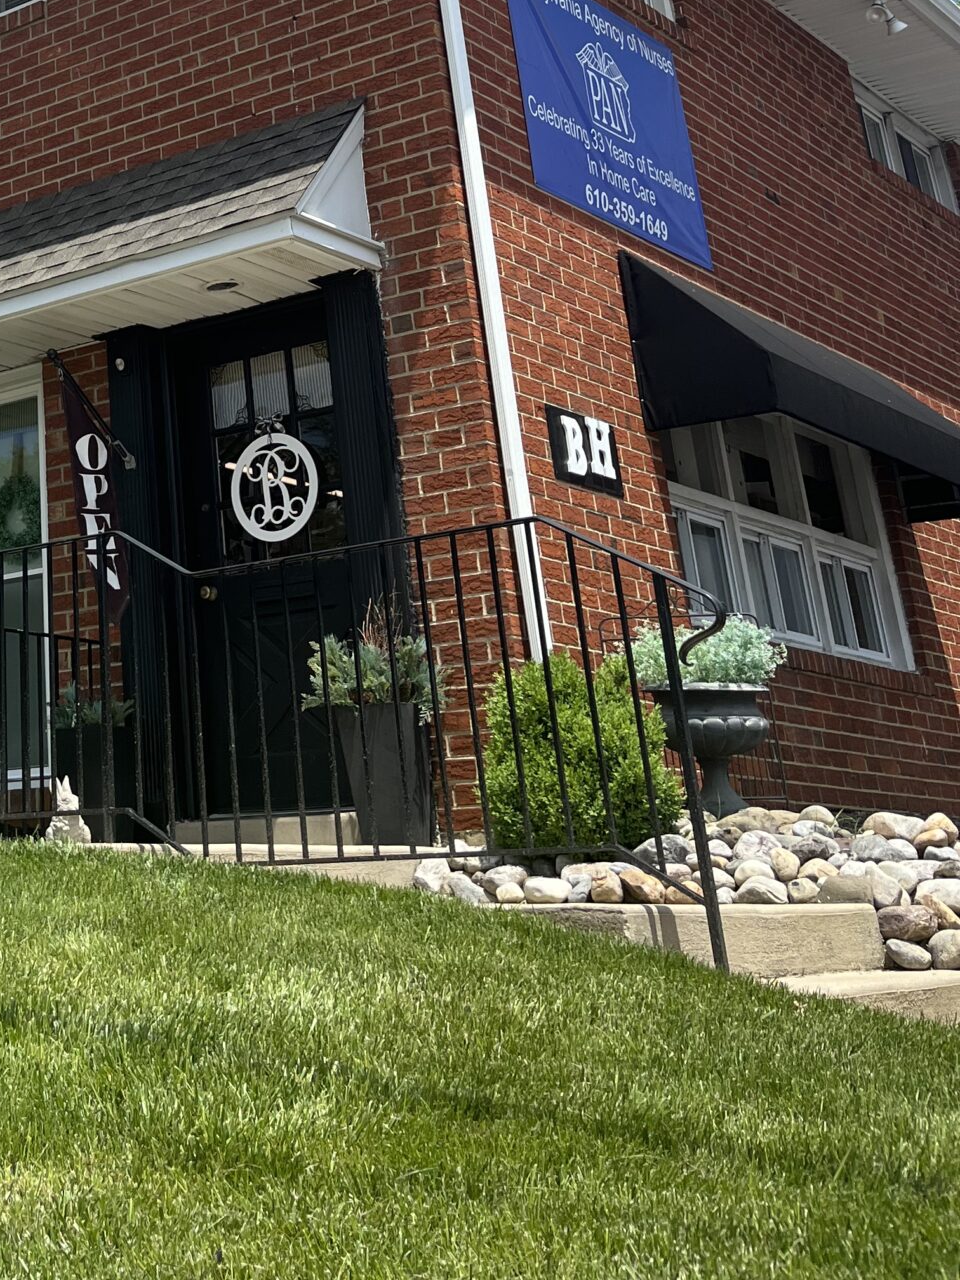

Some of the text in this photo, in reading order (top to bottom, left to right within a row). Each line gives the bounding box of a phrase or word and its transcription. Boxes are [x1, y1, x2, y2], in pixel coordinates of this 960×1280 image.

[584, 3, 624, 50] Agency
[626, 34, 638, 54] of
[637, 37, 675, 77] Nurses
[586, 69, 628, 135] PAN
[527, 94, 696, 202] Celebrating 33 Years of Excellence
[586, 153, 657, 207] In Home Care
[585, 183, 668, 242] 610-359-1649
[559, 414, 617, 480] BH
[74, 432, 121, 591] OPEN
